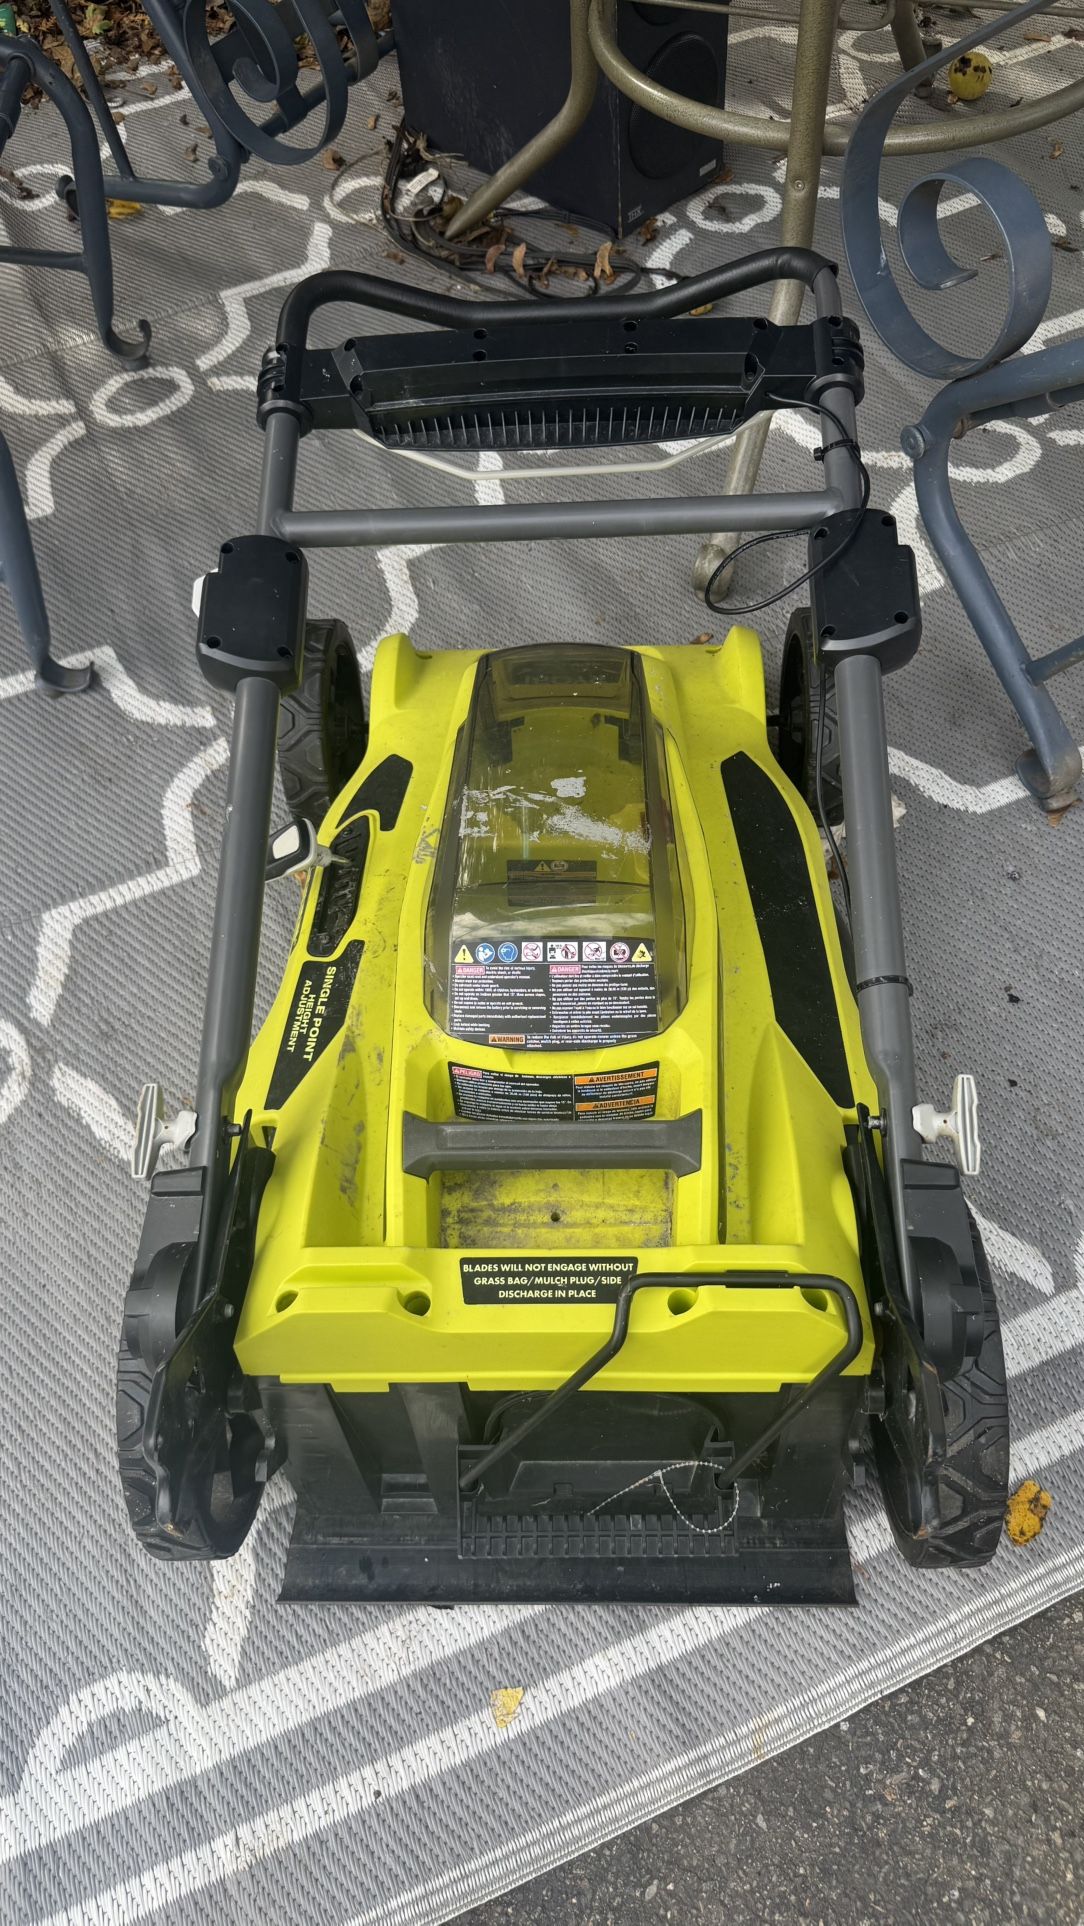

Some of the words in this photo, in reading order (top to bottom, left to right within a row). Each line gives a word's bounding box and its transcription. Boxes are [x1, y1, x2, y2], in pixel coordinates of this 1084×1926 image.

[315, 966, 337, 1015] SINGLE
[286, 979, 313, 1053] ADJUSTMENT
[299, 994, 316, 1034] HEIGHT
[303, 1017, 322, 1062] POINT
[459, 1068, 482, 1077] PELIGRO
[595, 1072, 645, 1083] AVERTISSEMENT
[599, 1099, 640, 1108] ADVERTENCIA
[463, 1264, 499, 1272] BLADES
[501, 1264, 523, 1272] WILL
[525, 1263, 546, 1272] NOT
[547, 1263, 587, 1272] ENGAGE
[588, 1263, 634, 1271] WITHOUT
[473, 1276, 506, 1285] GRASS
[507, 1275, 568, 1286] BAG/MULCH
[570, 1276, 622, 1286] PLUG/SIDE
[498, 1290, 553, 1298] DISCHARGE
[554, 1290, 566, 1298] IN
[568, 1289, 597, 1298] PLACE
